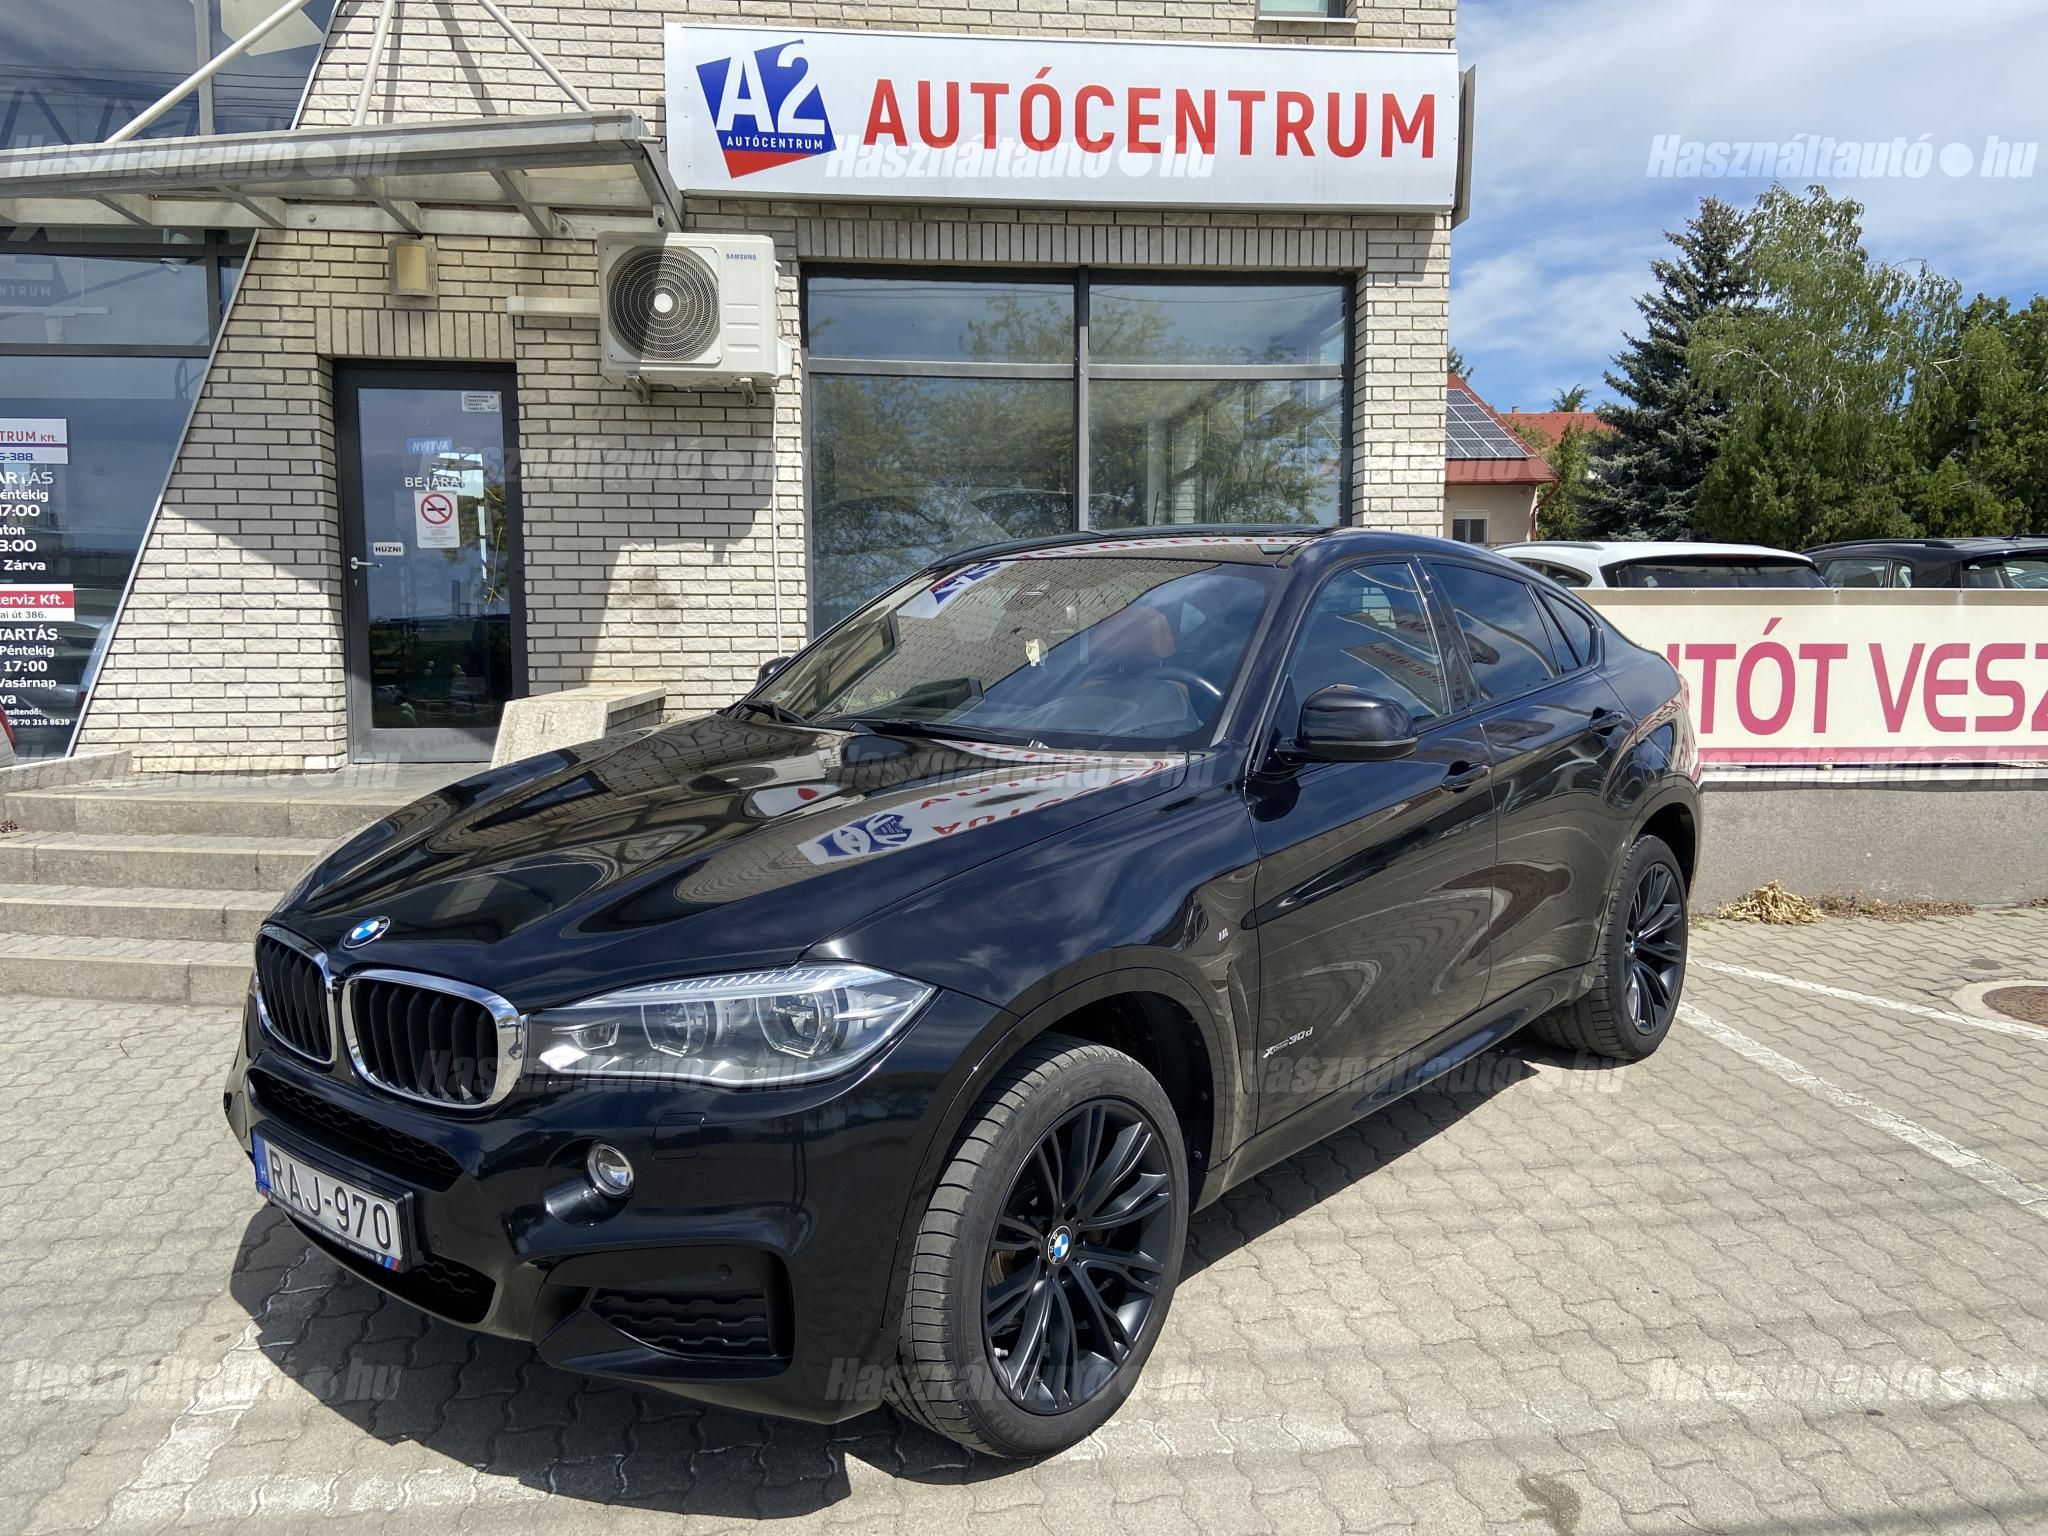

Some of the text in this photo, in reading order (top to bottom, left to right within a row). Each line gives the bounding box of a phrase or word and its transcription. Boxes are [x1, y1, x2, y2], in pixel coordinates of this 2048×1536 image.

[715, 40, 826, 136] A2
[865, 65, 1435, 159] AUTÓCENTRUM
[726, 134, 823, 150] AUTÓCENTRUM
[726, 253, 757, 261] SAMSUNG
[41, 434, 57, 442] Kft.
[0, 489, 49, 502] éntekig
[4, 559, 46, 571] Zárva
[40, 594, 65, 605] Kft.
[0, 645, 55, 658] Péntekig
[4, 660, 48, 673] 17:00
[1667, 617, 1848, 736] TÓT
[20, 718, 30, 726] 70
[269, 1149, 392, 1250] RAJ-970
